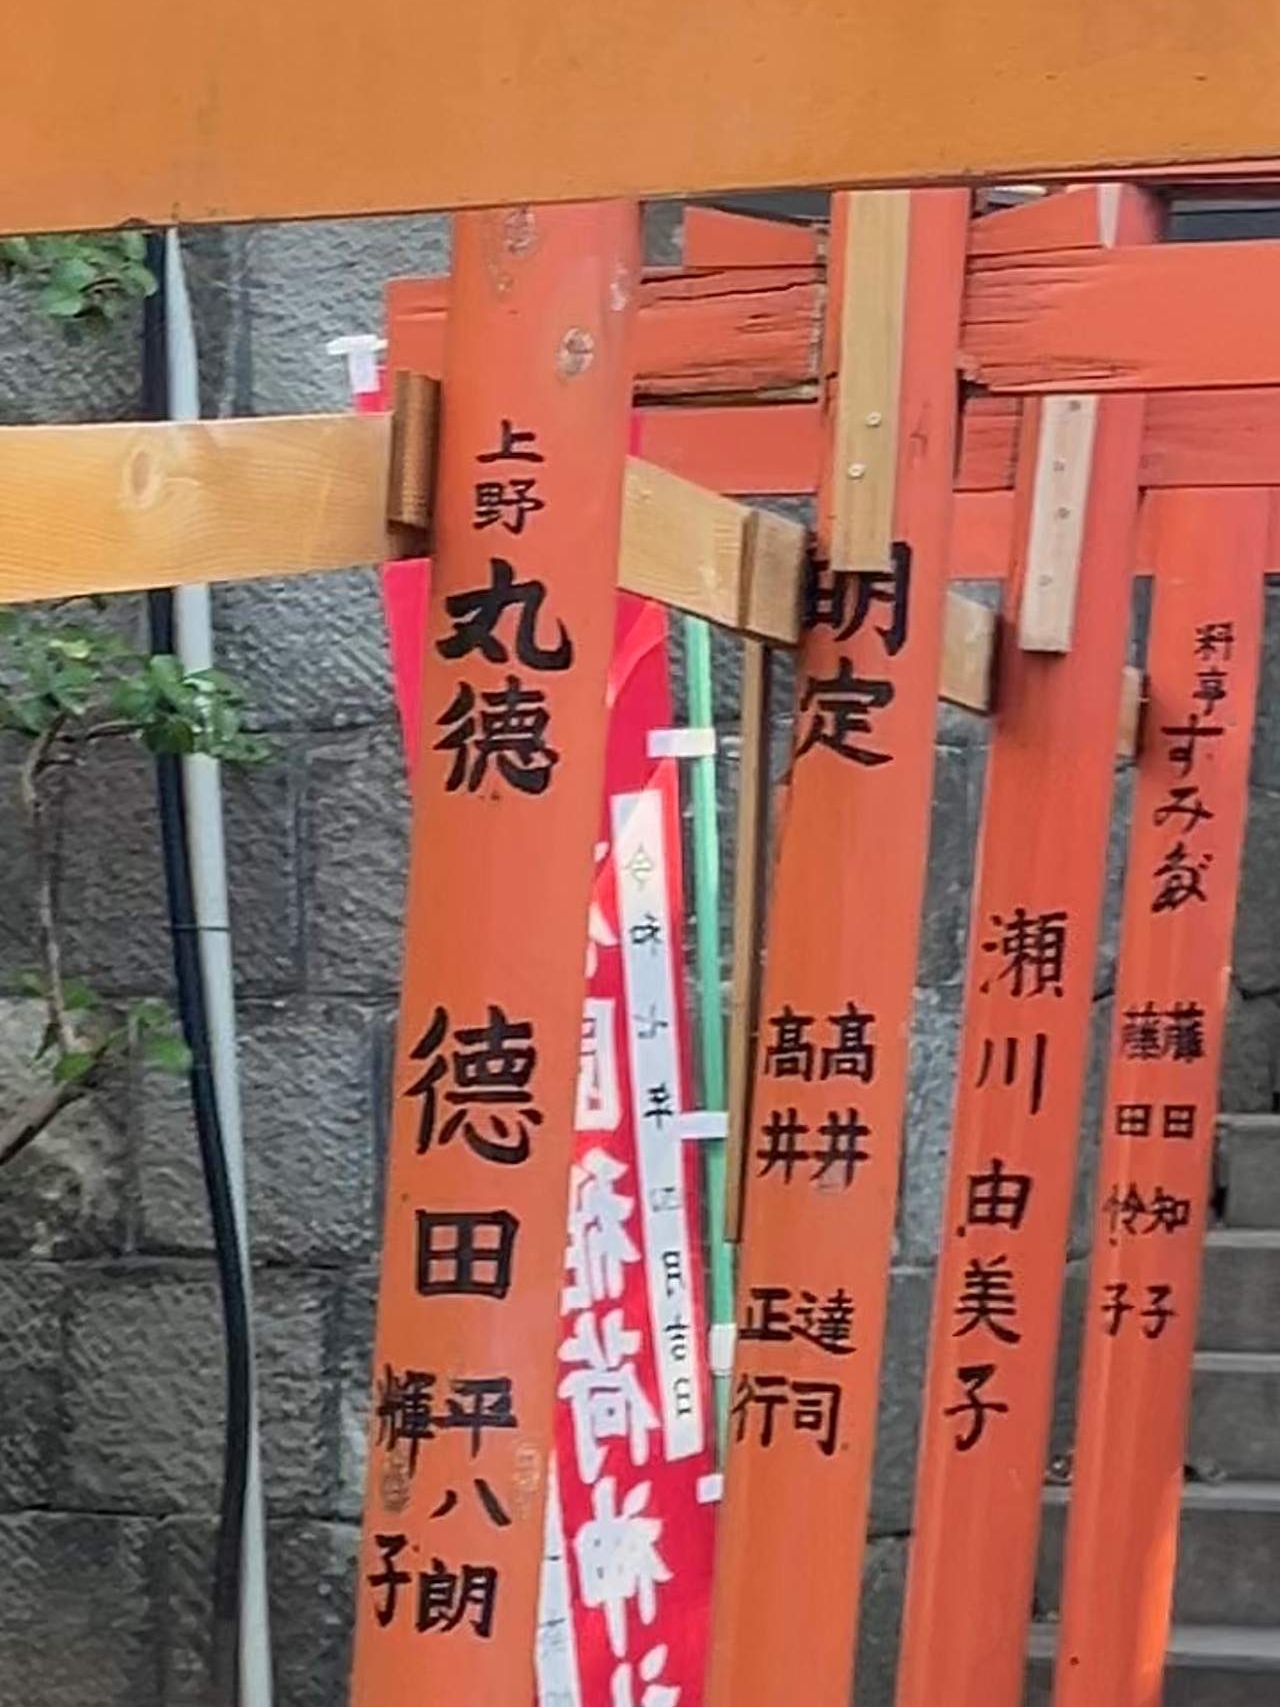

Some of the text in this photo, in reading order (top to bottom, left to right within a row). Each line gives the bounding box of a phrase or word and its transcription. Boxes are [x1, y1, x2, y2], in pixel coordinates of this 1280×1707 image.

[474, 419, 546, 536] 上野
[943, 906, 1068, 1452] 瀬川由美子
